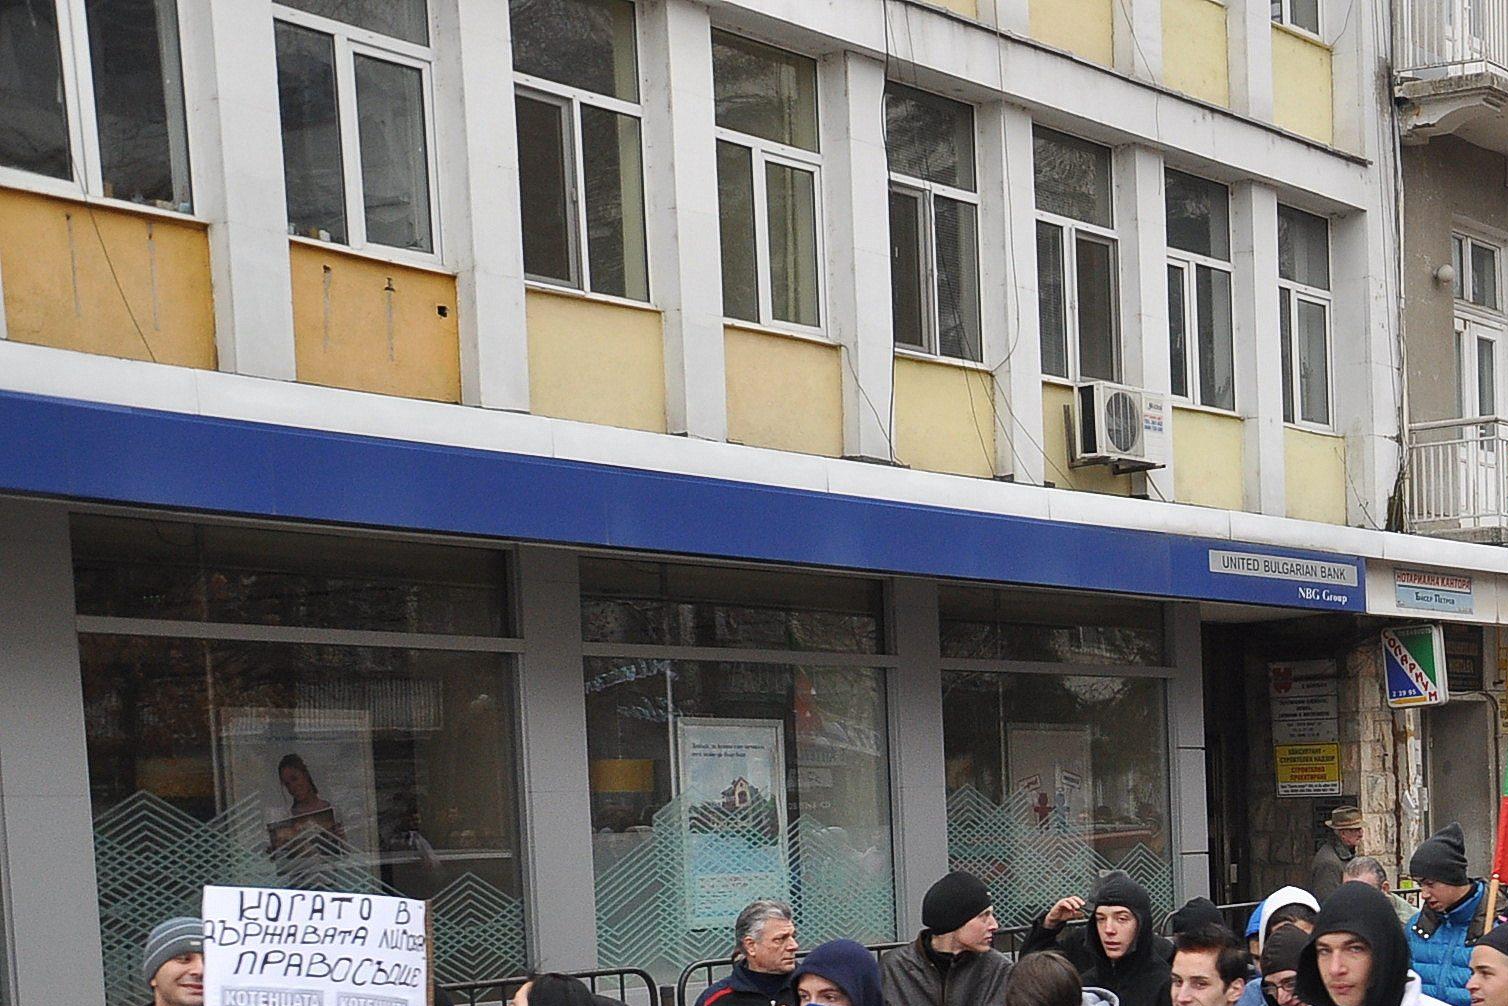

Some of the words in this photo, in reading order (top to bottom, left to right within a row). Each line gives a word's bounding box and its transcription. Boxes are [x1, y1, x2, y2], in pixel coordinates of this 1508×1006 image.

[1222, 555, 1260, 572] UNITED
[1263, 559, 1318, 578] BULGARIAN
[1320, 566, 1347, 581] BANK
[1396, 571, 1440, 587] НОТАРИАЛНА
[1440, 575, 1473, 590] КАНТОРА
[1298, 586, 1320, 600] NBG
[1322, 590, 1348, 605] Group
[238, 890, 373, 923] КОГАТО
[395, 900, 411, 925] В
[202, 919, 369, 946] ДЪРЖАВАТА
[233, 949, 421, 988] ПРАВОСЪДИЕ
